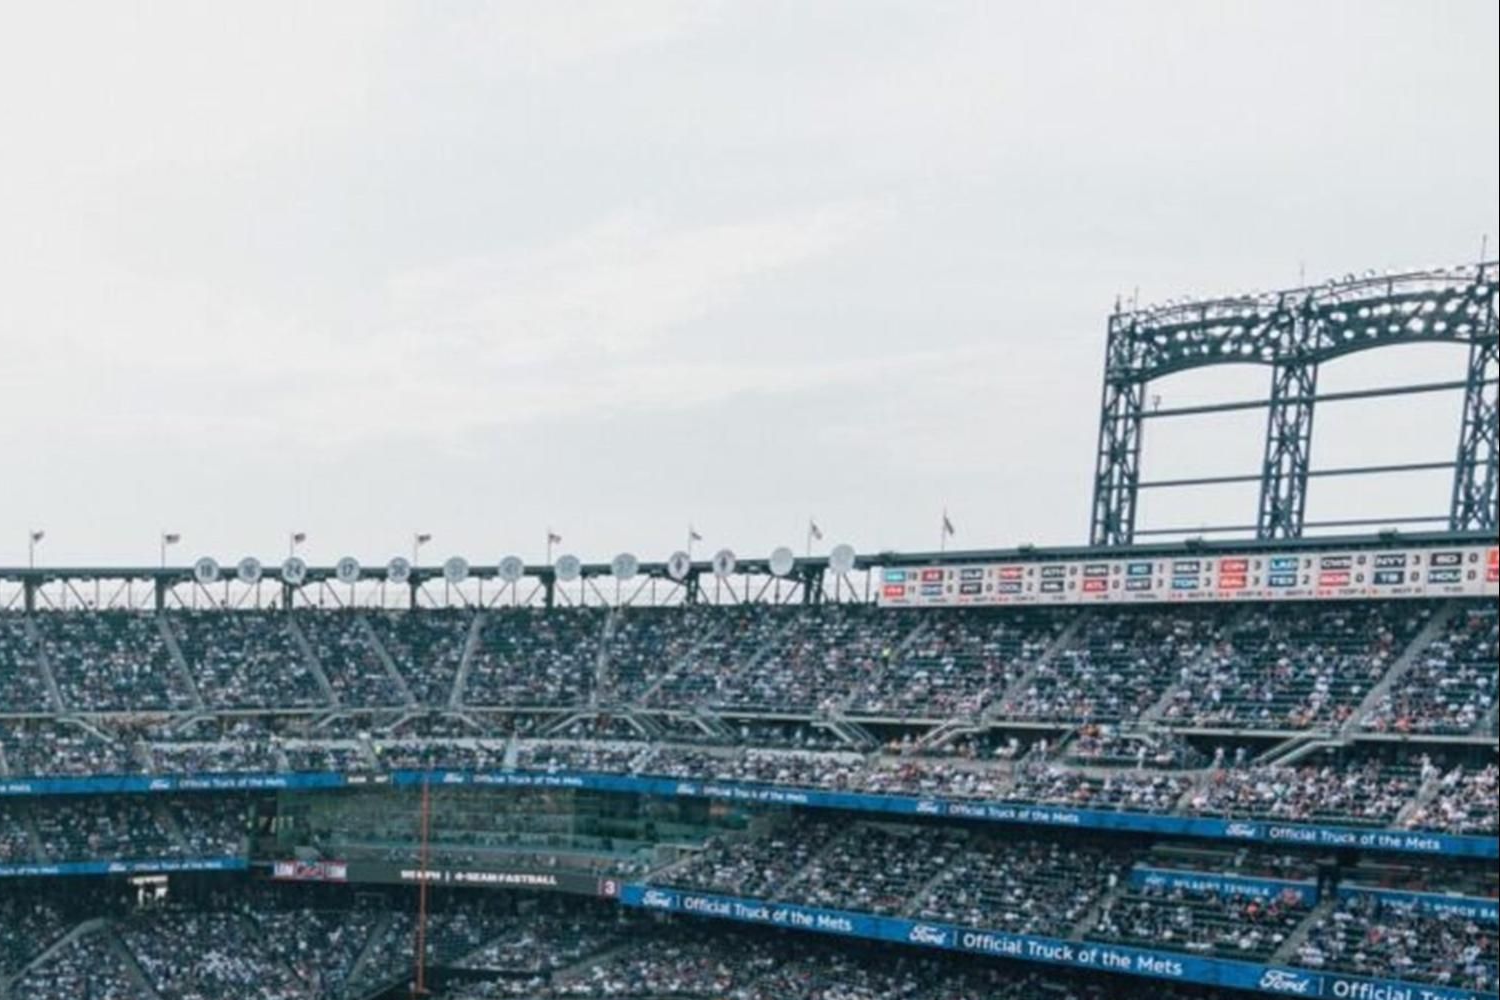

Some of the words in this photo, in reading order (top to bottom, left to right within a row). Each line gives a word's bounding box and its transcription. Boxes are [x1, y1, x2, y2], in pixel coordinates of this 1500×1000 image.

[949, 803, 985, 817] Official
[988, 806, 1015, 819] Truck
[1018, 807, 1029, 819] of
[1032, 808, 1049, 820] the
[1052, 811, 1079, 824] Mets
[1226, 823, 1255, 837] Ford
[1269, 826, 1316, 841] Official
[1320, 830, 1355, 843] Truck
[1360, 833, 1375, 846] of
[1379, 834, 1401, 848] the
[1405, 836, 1441, 851] Mets
[604, 881, 615, 894] 3
[642, 891, 672, 907] Ford
[684, 896, 730, 916] Official
[735, 903, 769, 920] Truck
[772, 906, 788, 921] of
[791, 910, 813, 927] the
[817, 914, 852, 932] Mets
[909, 924, 947, 946] Ford
[963, 931, 1022, 955] Official
[1027, 940, 1073, 962] Truck
[1078, 947, 1097, 965] of
[1101, 949, 1132, 968] the
[1137, 955, 1183, 977] Mets
[1259, 968, 1311, 993] Ford
